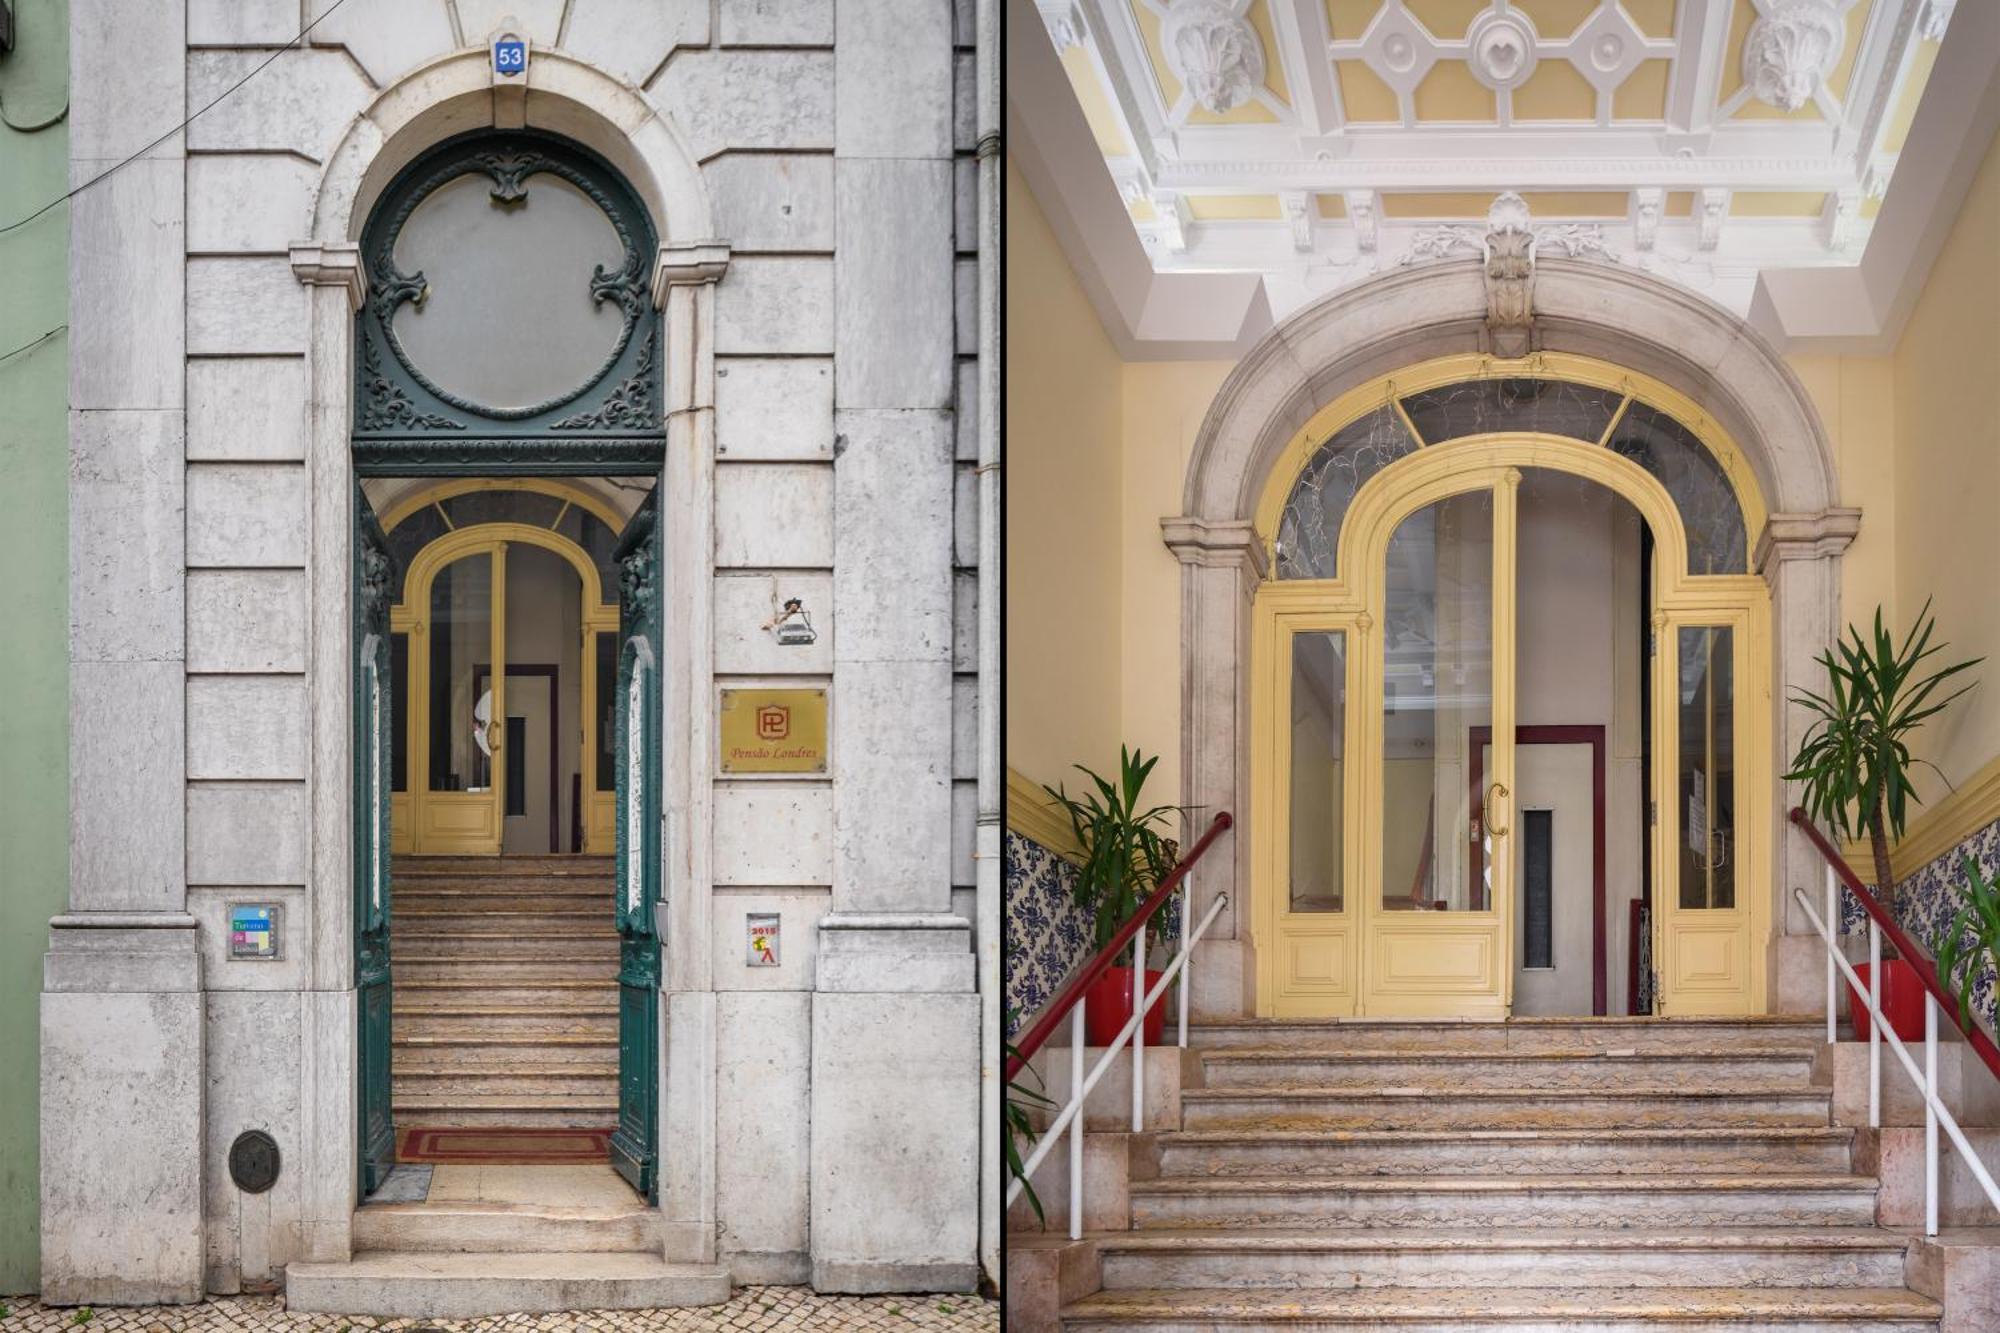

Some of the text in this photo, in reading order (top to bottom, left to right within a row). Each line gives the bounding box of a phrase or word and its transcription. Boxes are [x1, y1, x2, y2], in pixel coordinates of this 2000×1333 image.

[499, 48, 521, 65] 53
[731, 746, 816, 759] Pensão Londres
